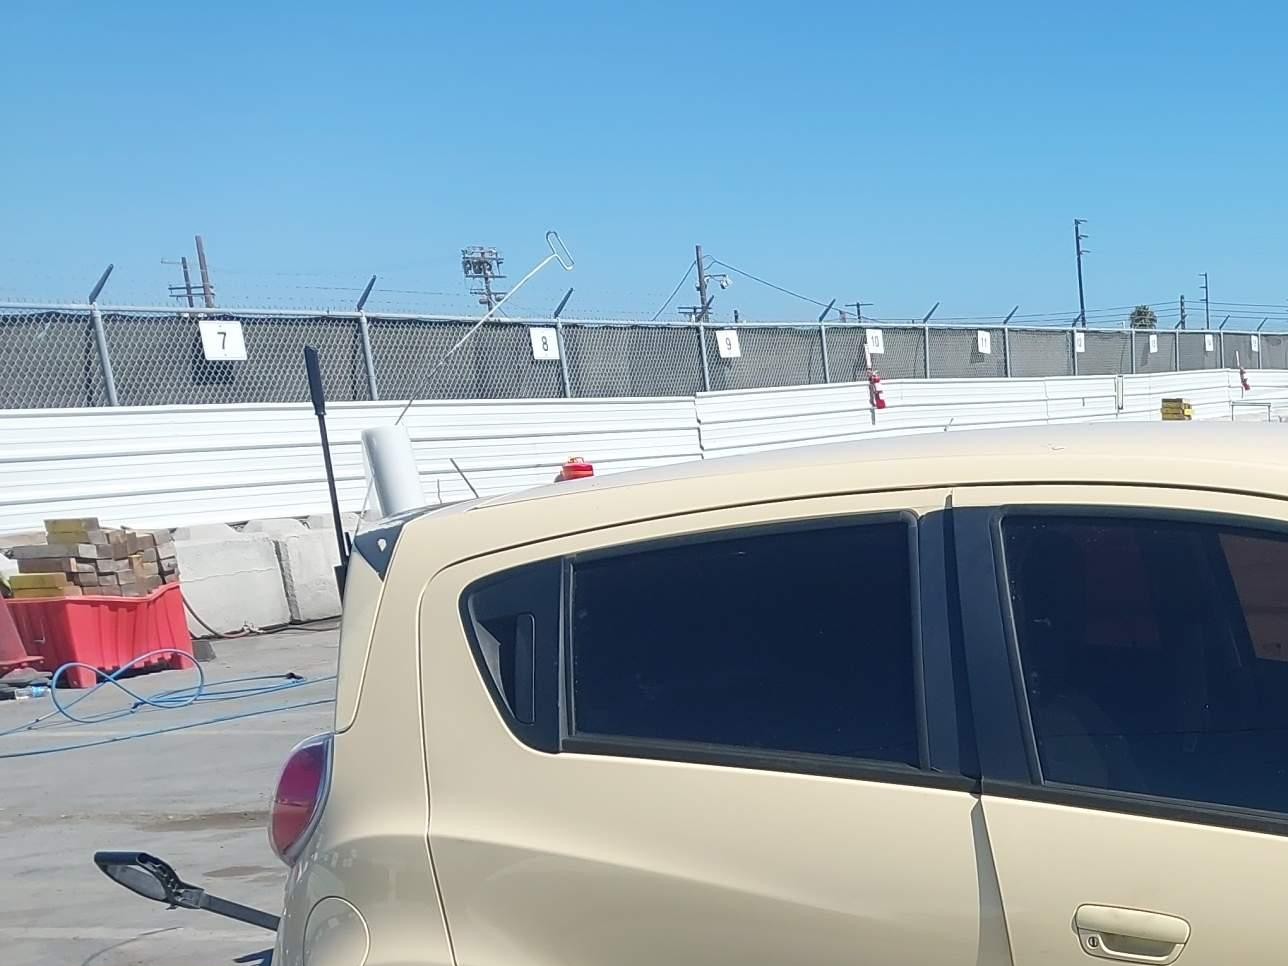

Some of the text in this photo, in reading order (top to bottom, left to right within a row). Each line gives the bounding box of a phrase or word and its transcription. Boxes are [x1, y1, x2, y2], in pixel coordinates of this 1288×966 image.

[217, 331, 227, 350] 7
[541, 335, 549, 352] 8
[725, 337, 732, 351] 9
[871, 335, 880, 348] 10
